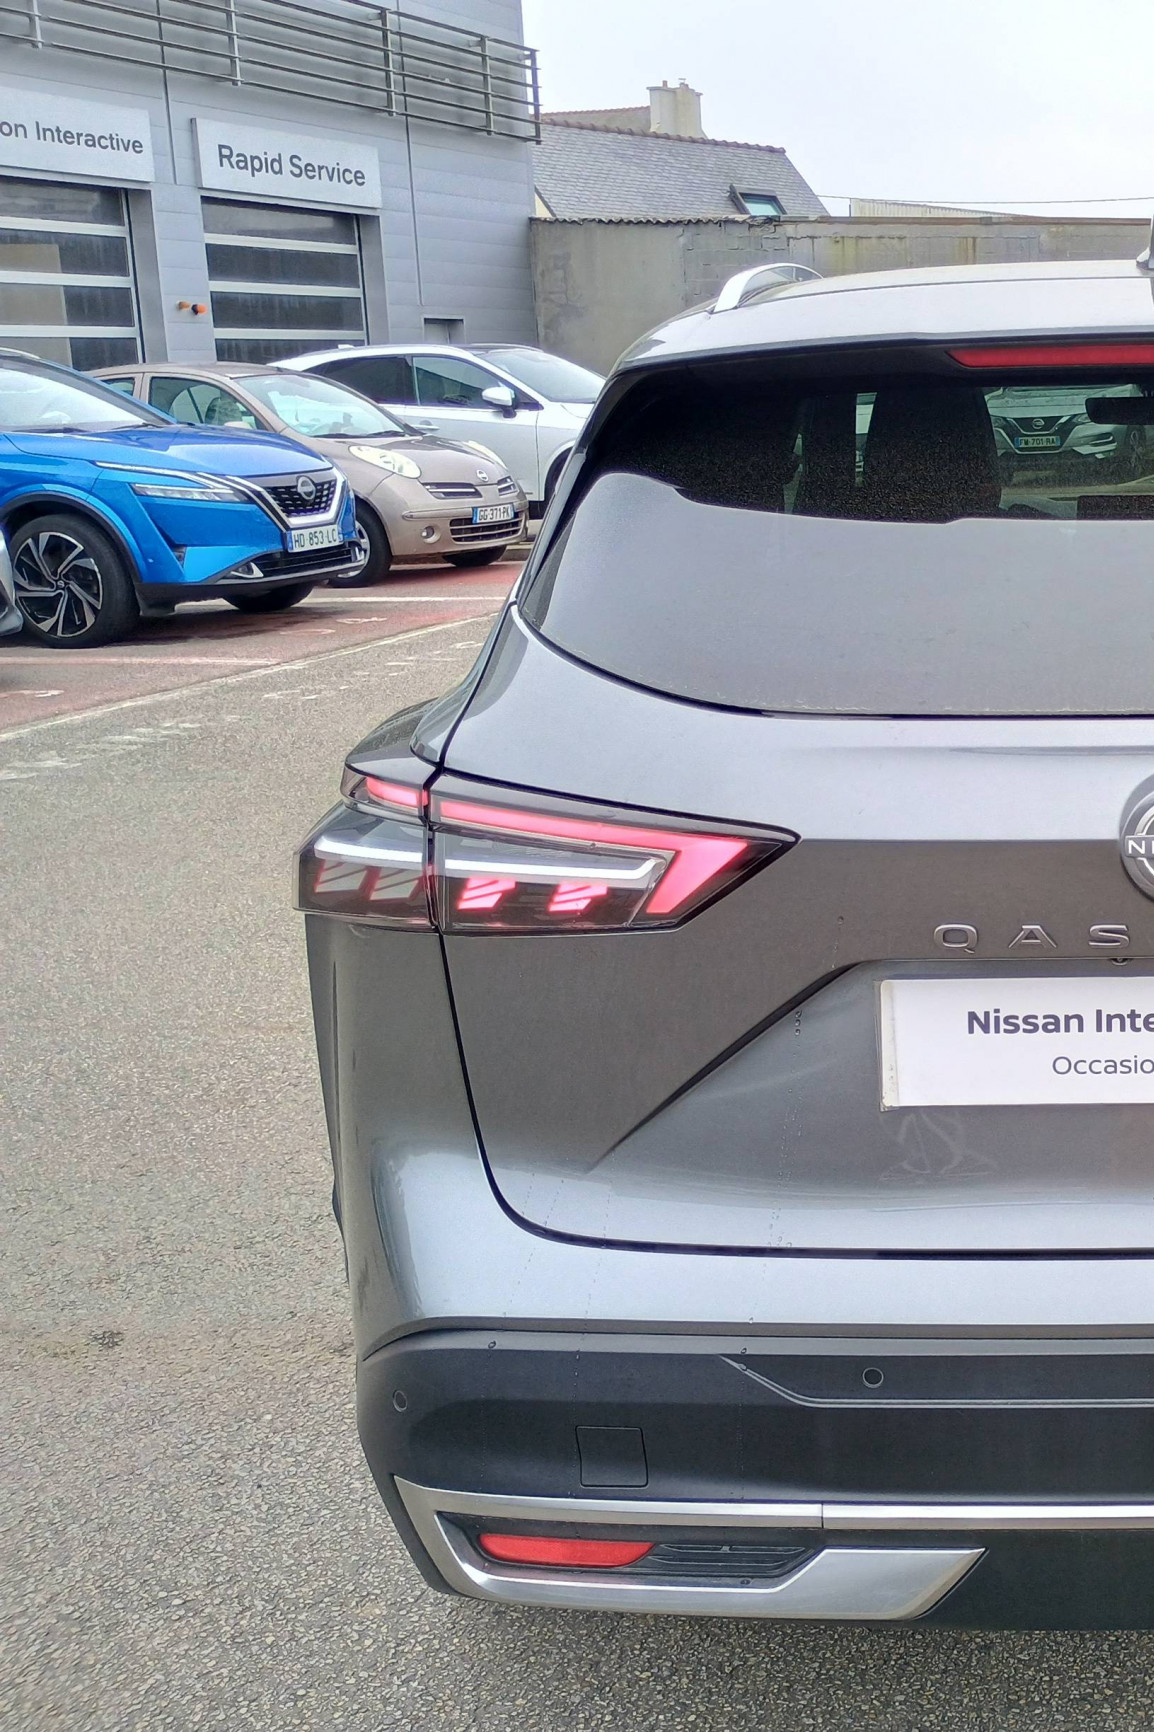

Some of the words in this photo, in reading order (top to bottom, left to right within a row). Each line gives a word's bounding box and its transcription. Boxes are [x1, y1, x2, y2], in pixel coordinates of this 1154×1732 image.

[0, 121, 28, 139] on
[35, 121, 144, 154] Interactive
[217, 143, 284, 178] Rapid
[289, 154, 366, 187] Service
[967, 1008, 1084, 1035] Nissan
